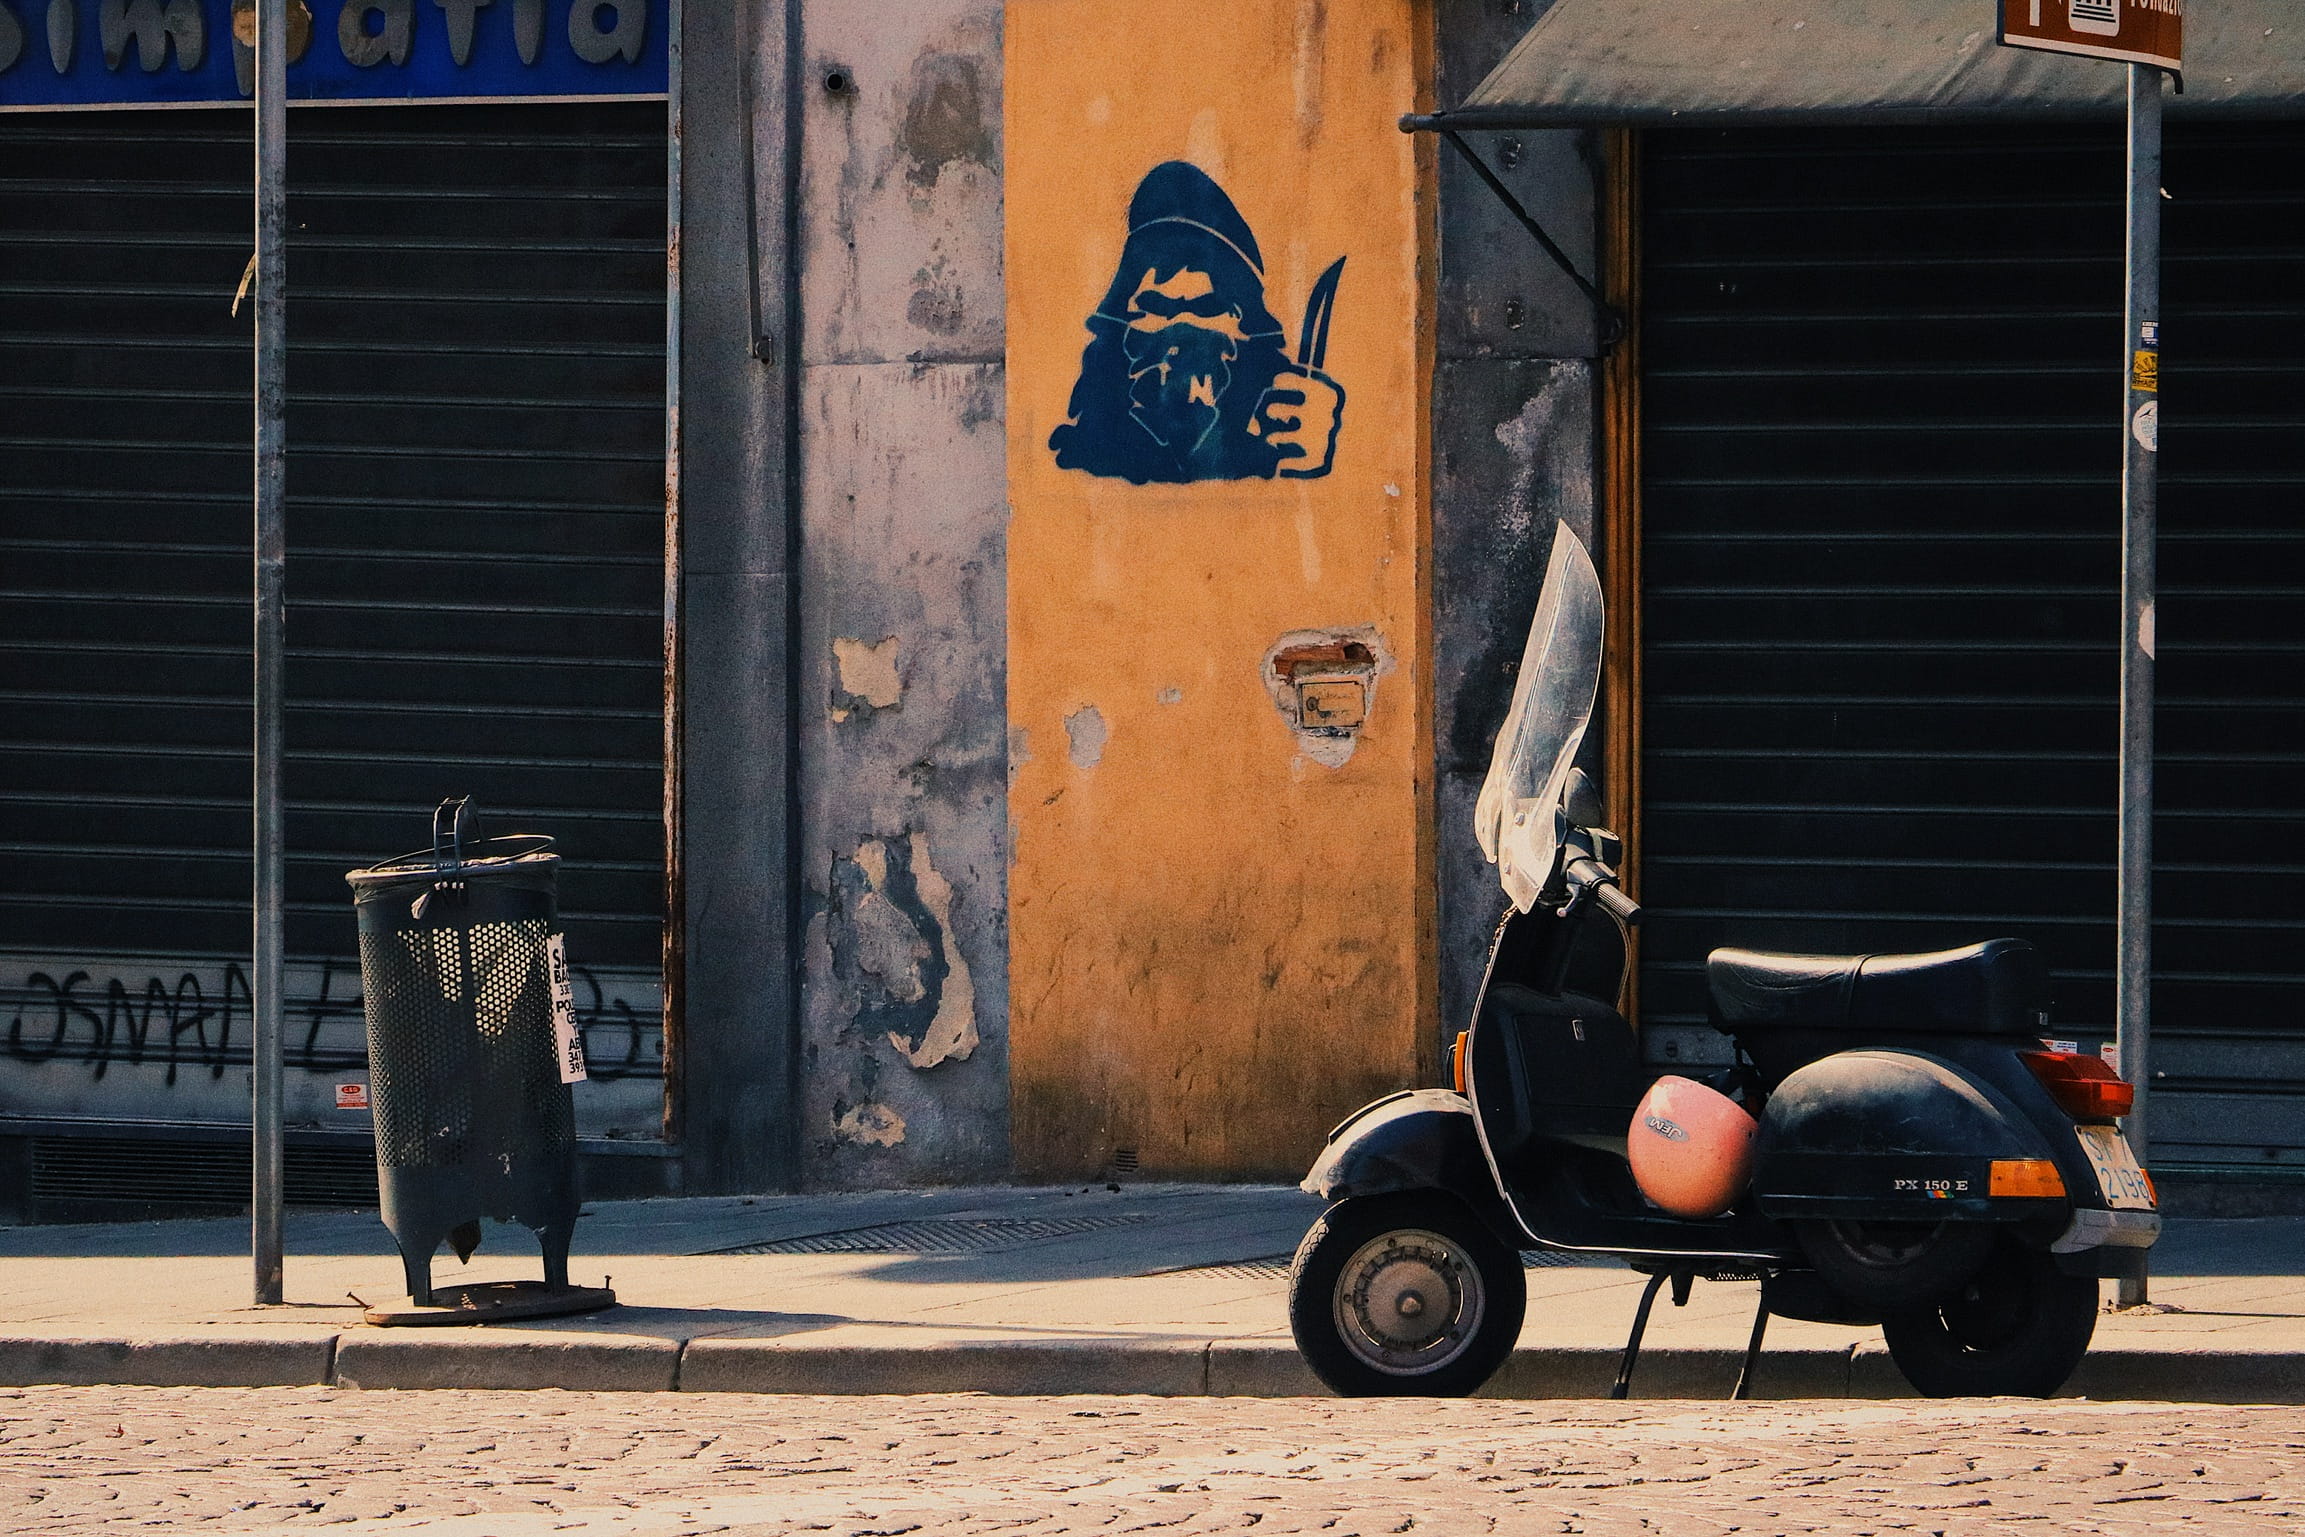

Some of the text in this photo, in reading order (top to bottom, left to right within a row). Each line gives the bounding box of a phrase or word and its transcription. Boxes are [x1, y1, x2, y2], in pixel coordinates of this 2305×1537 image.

[0, 0, 648, 97] impatia
[1894, 1179, 1968, 1191] PX 150 E
